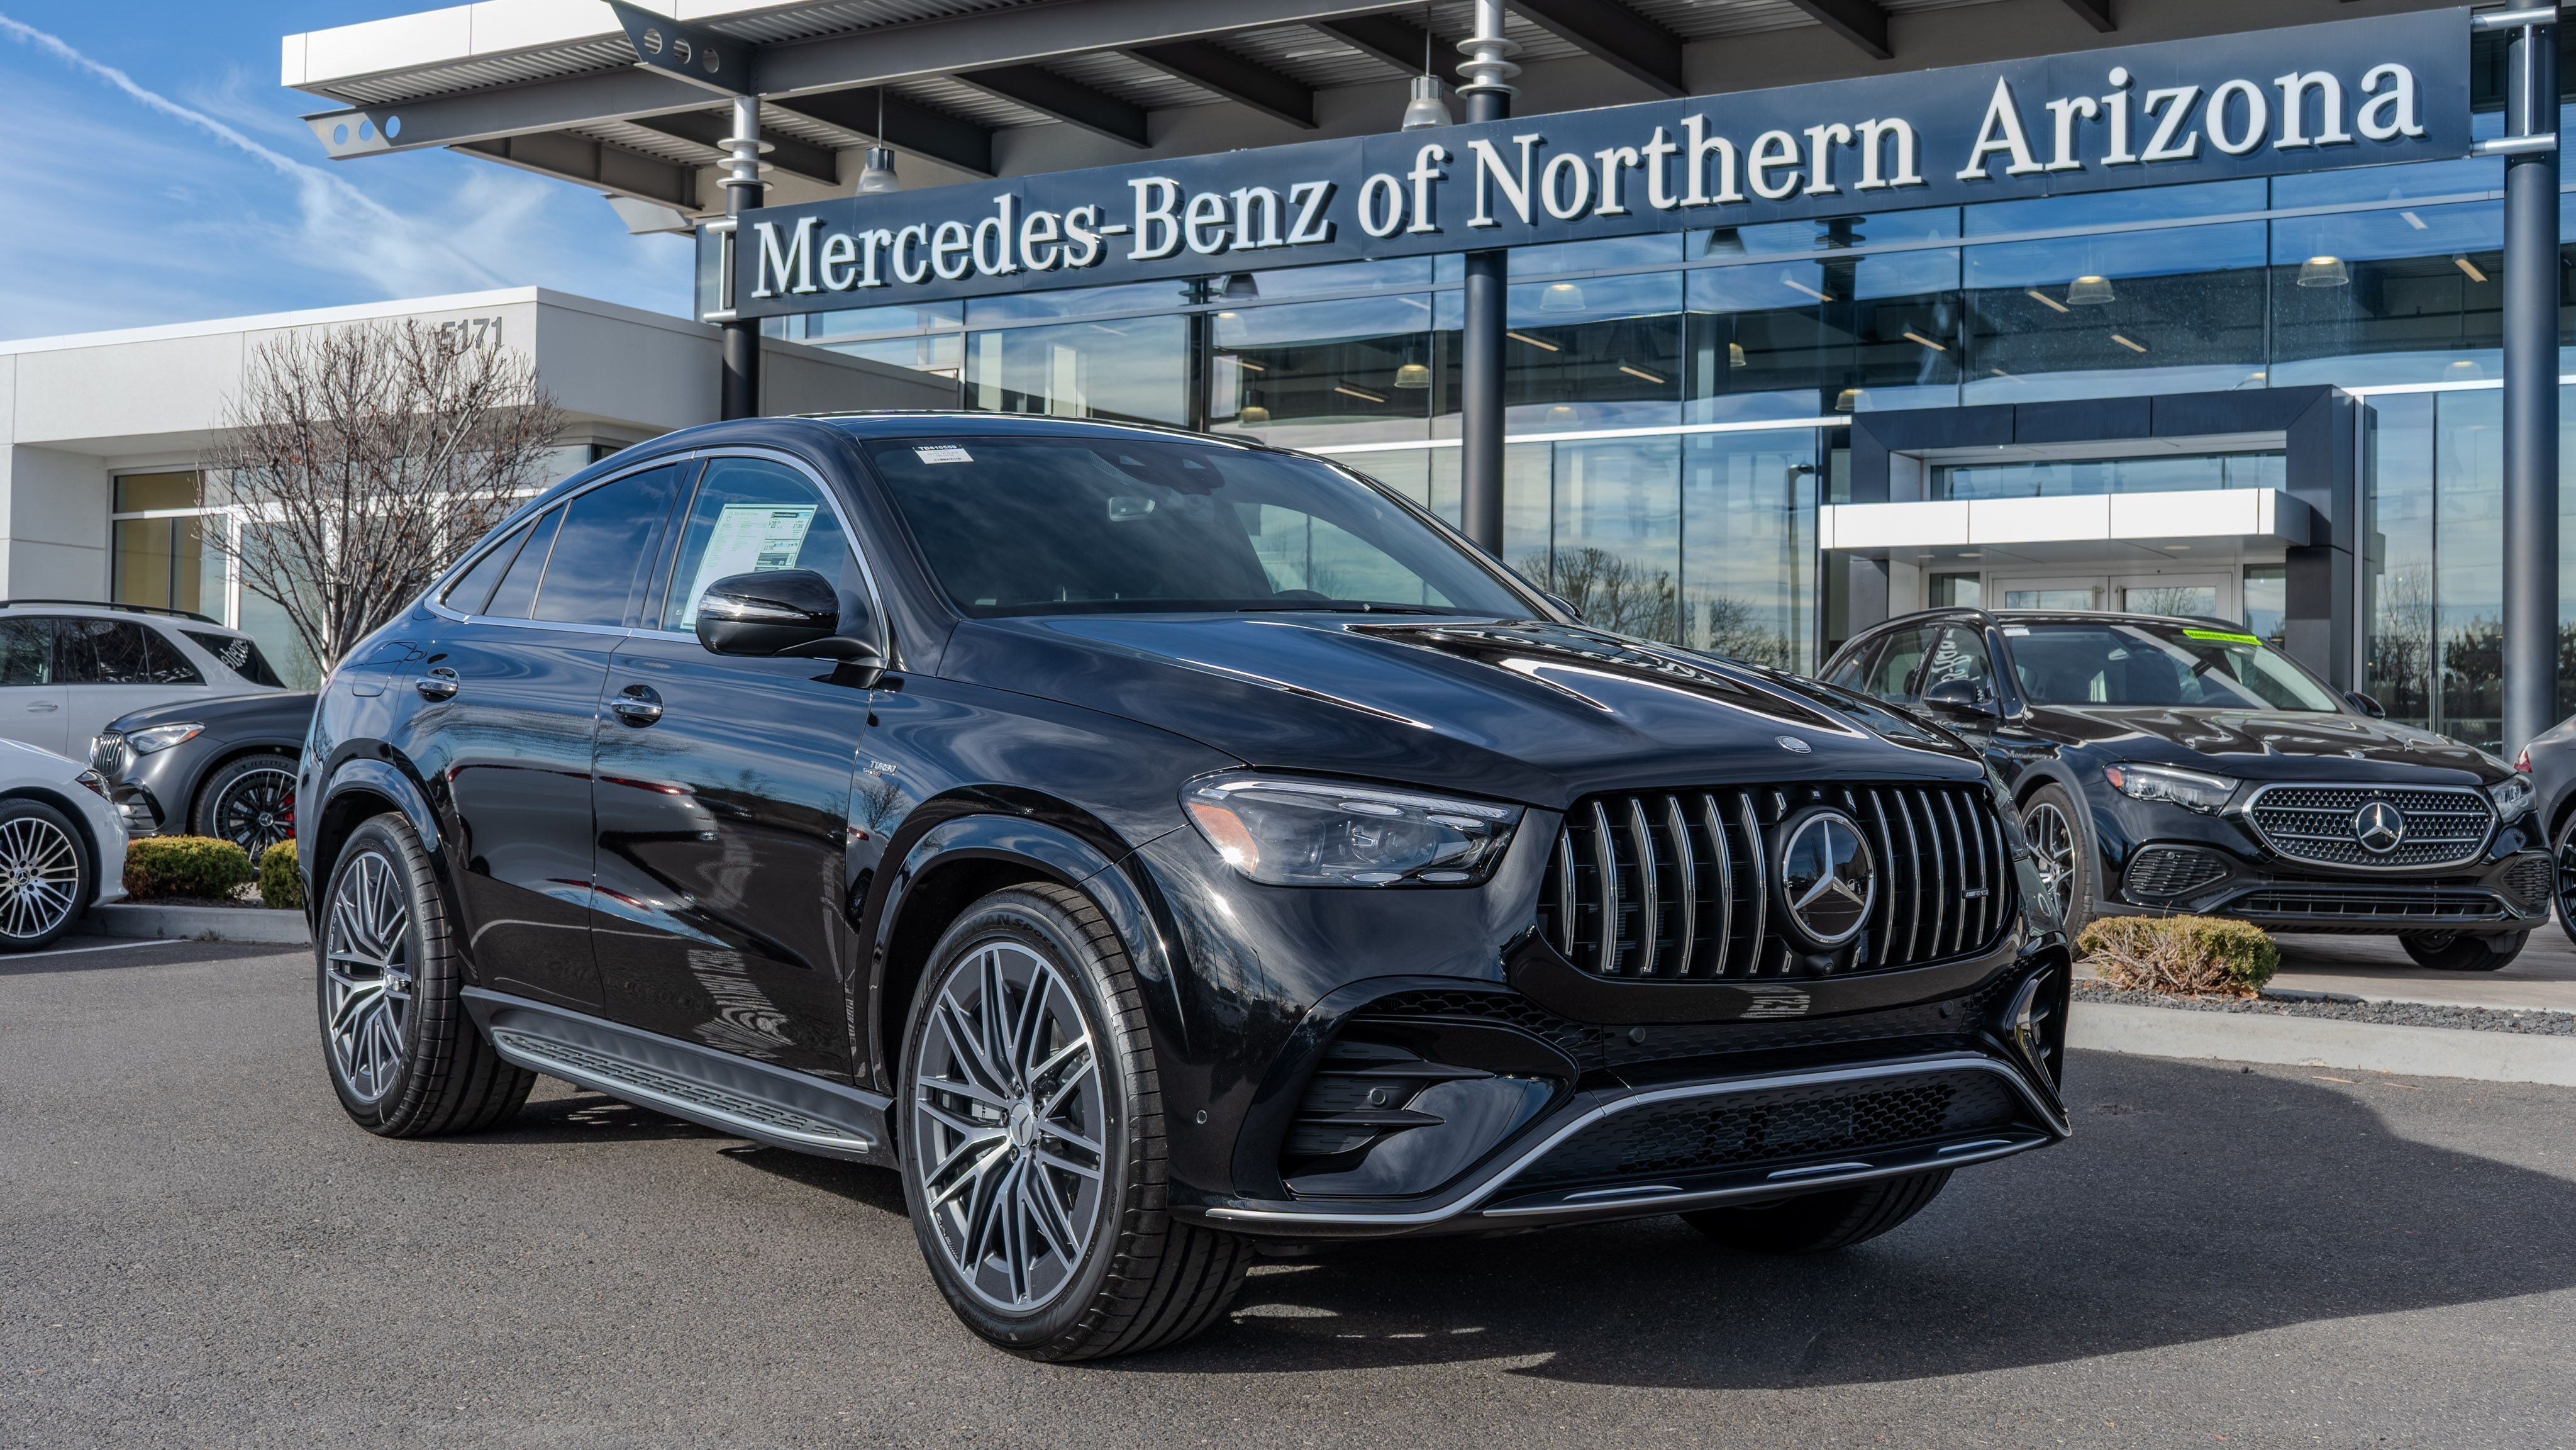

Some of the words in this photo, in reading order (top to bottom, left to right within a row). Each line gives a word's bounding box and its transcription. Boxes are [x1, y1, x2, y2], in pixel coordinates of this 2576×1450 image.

[752, 176, 1330, 298] Mercedes-Benz
[1358, 143, 1445, 237] of
[1467, 113, 1923, 227] Northern
[1956, 63, 2423, 180] Arizona
[441, 316, 502, 350] 5171
[870, 761, 896, 772] TURBO
